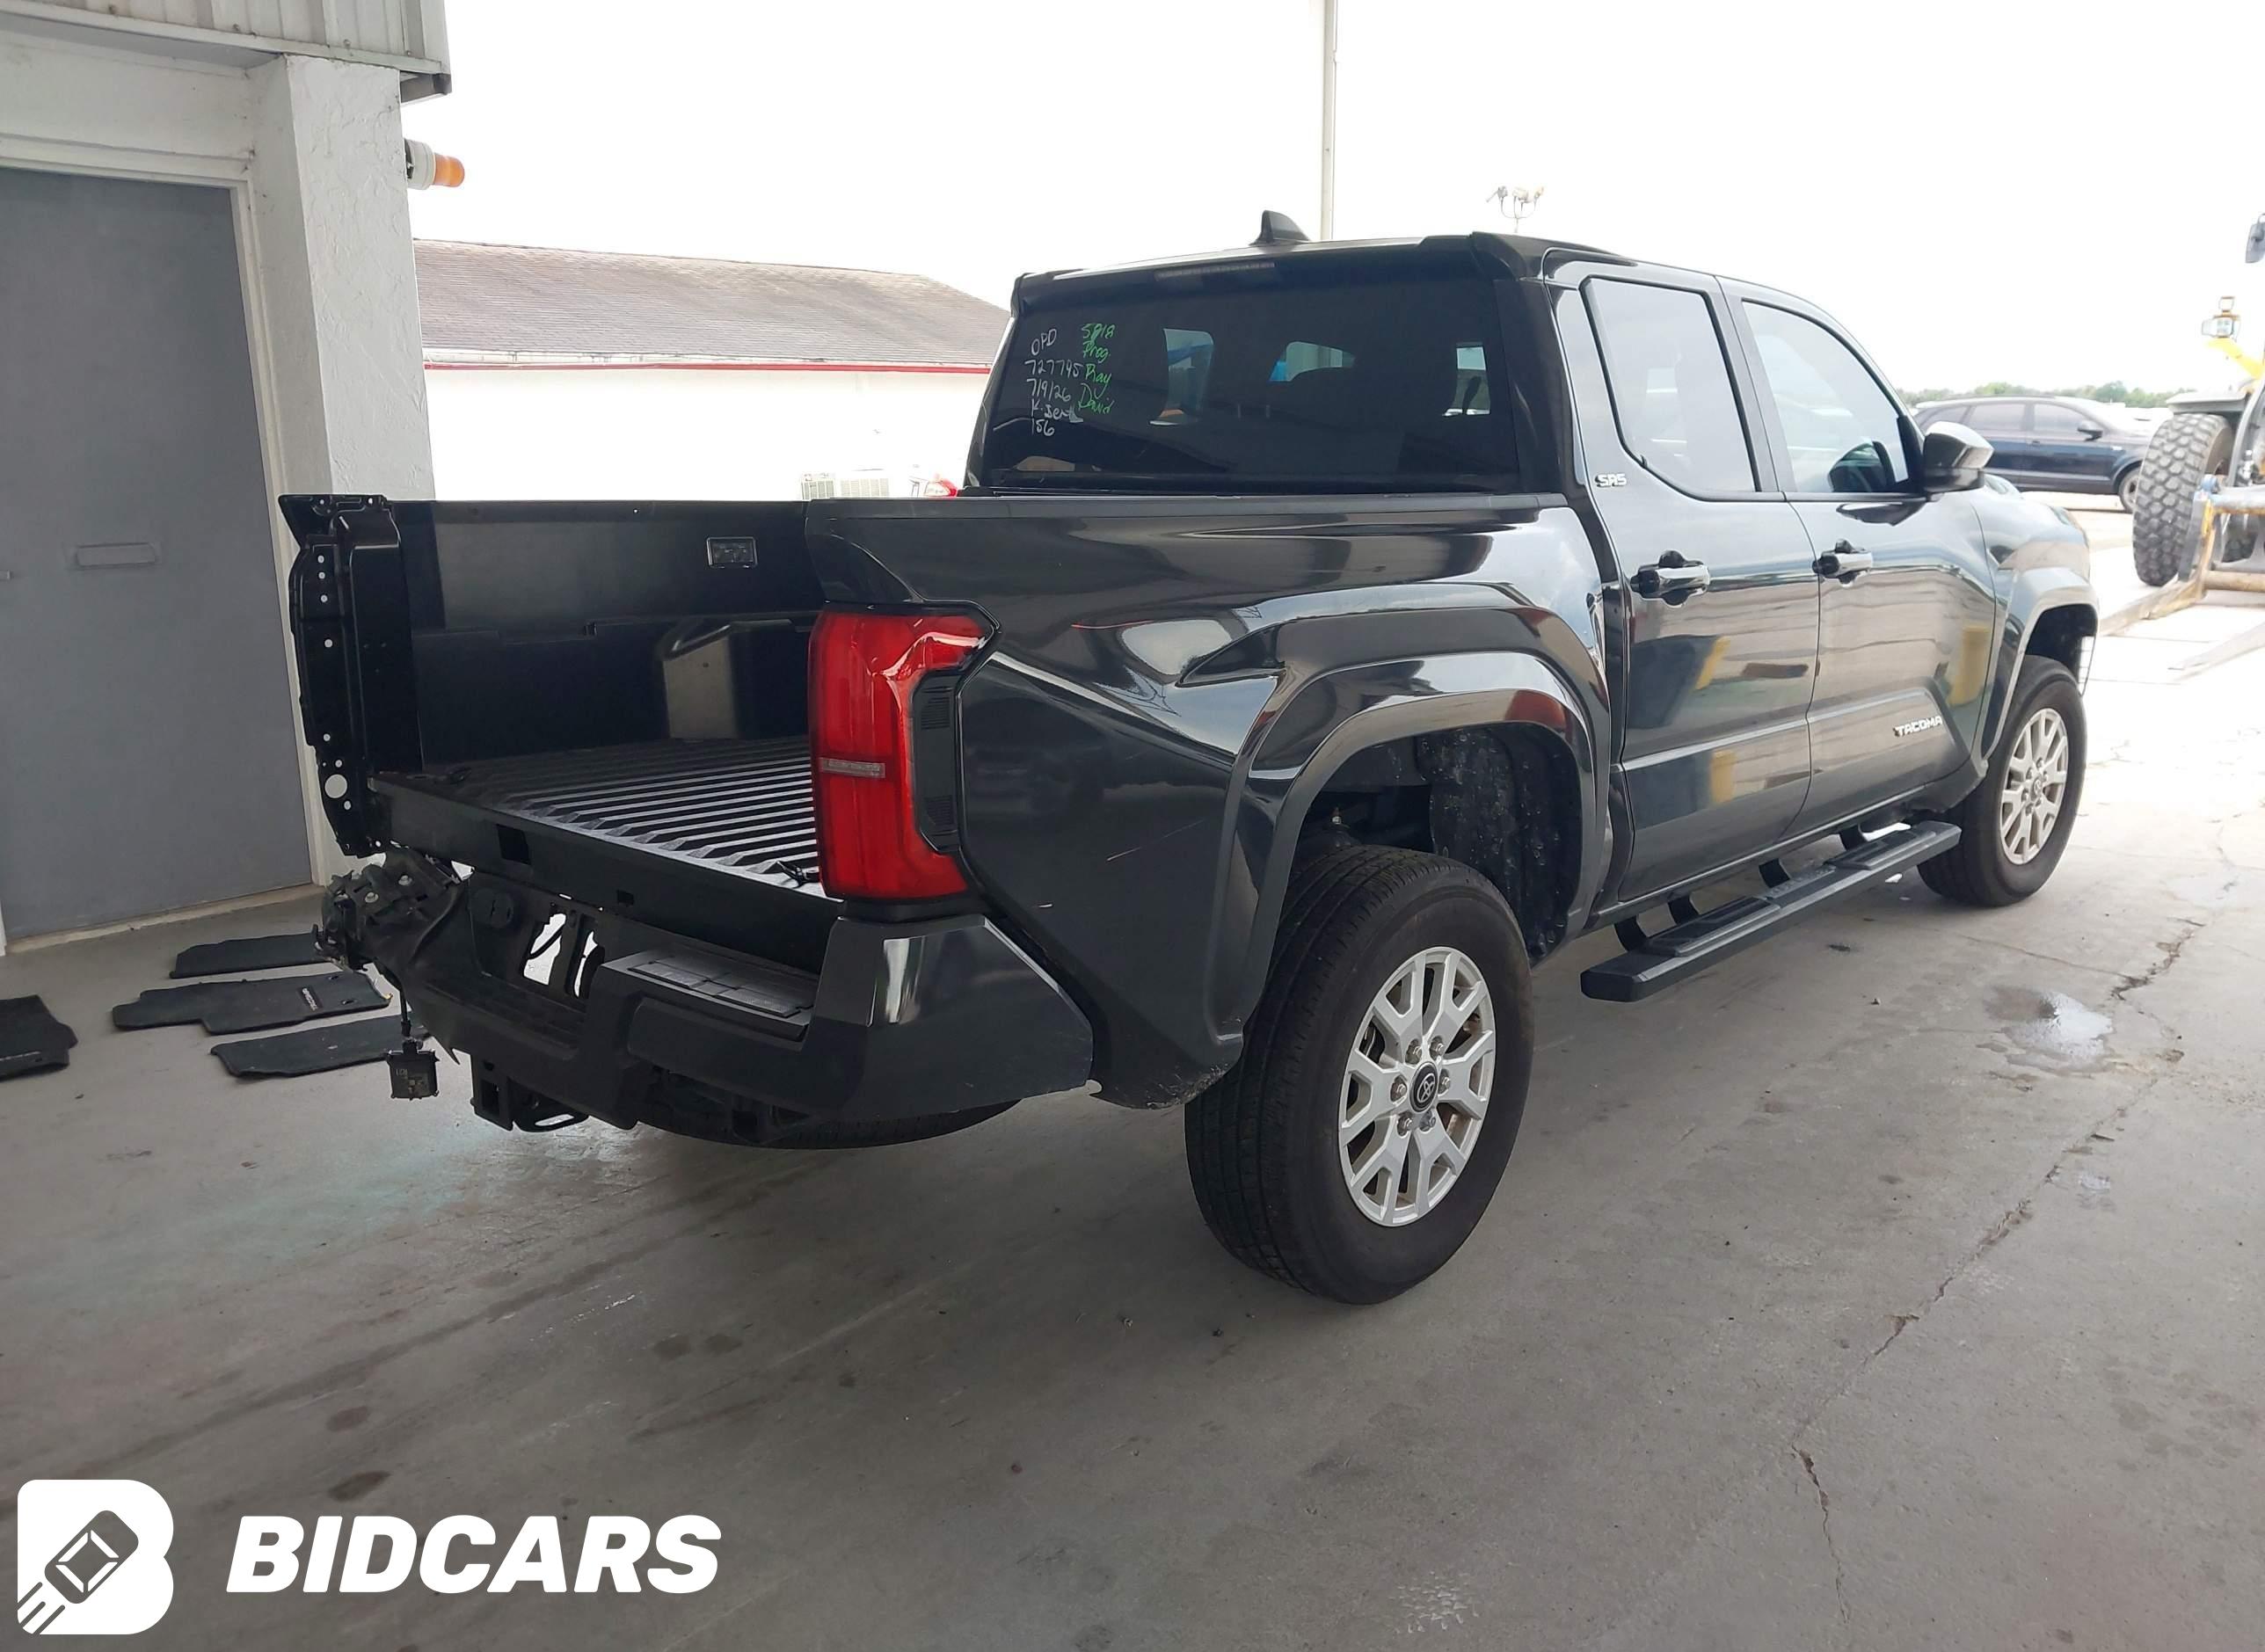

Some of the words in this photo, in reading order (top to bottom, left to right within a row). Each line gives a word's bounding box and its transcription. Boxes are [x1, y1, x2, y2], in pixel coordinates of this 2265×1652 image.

[1031, 328, 1057, 356] OPD
[1031, 418, 1055, 437] 156
[1892, 715, 1943, 738] TACOMA
